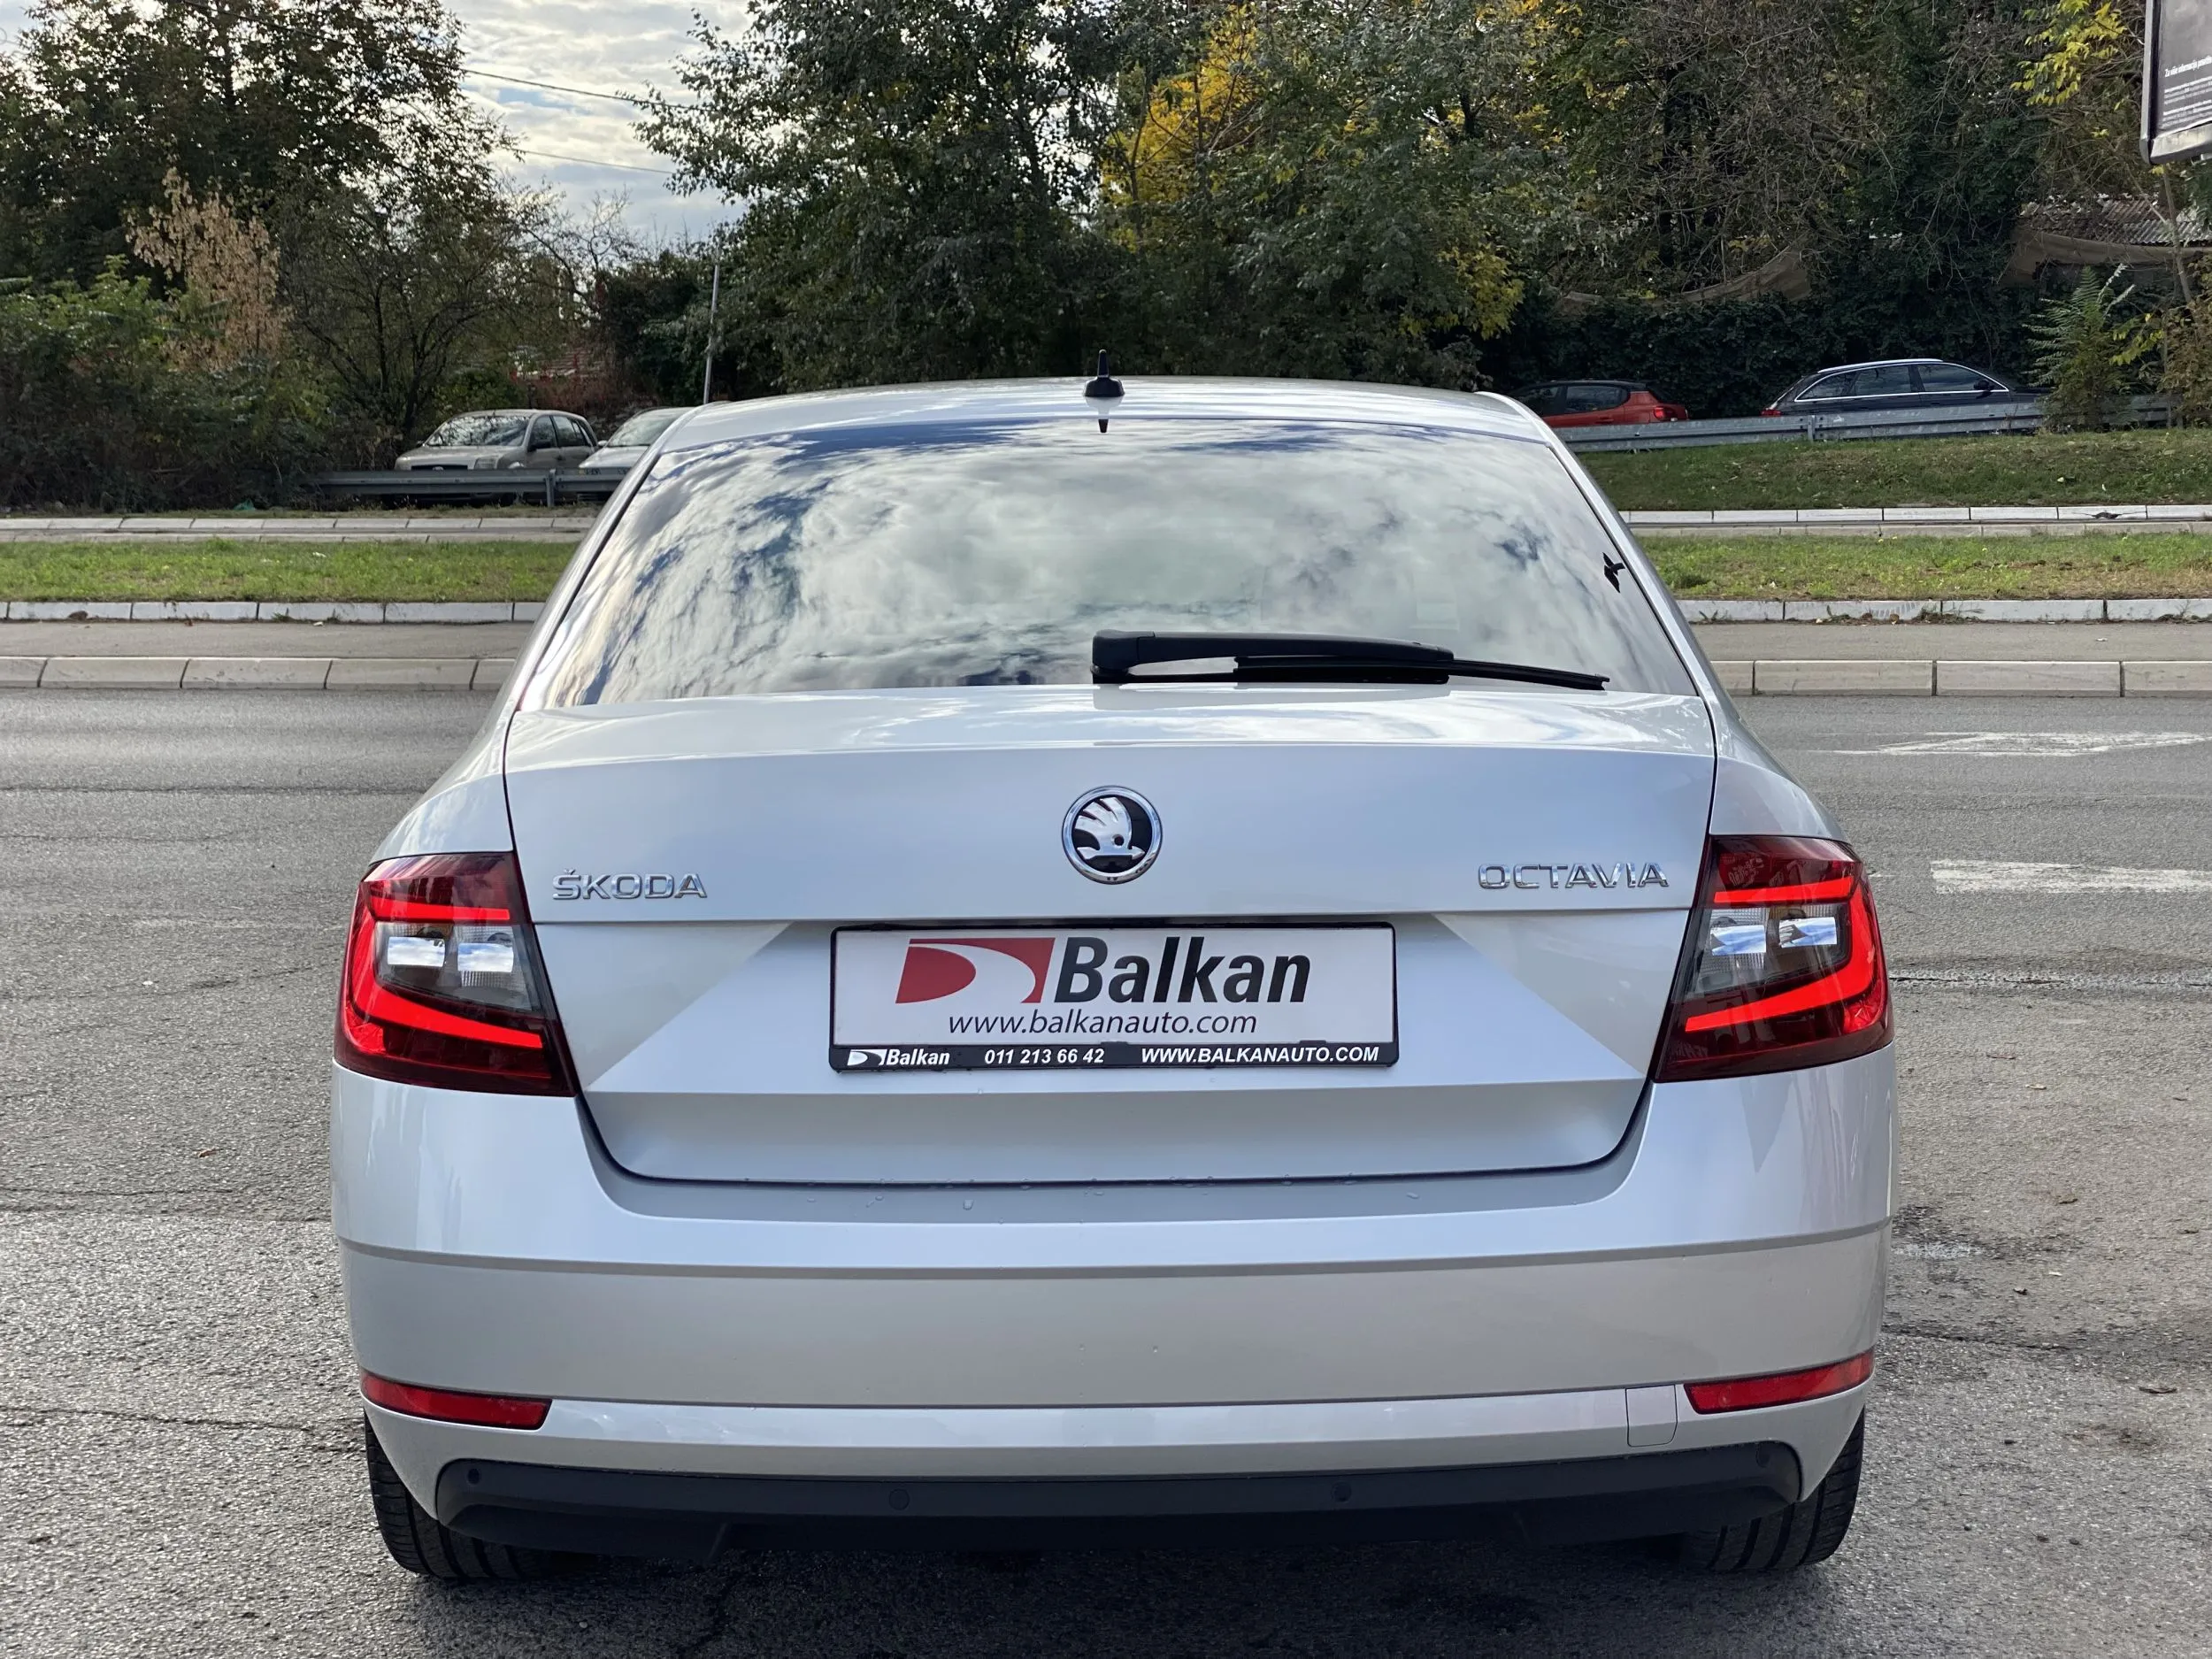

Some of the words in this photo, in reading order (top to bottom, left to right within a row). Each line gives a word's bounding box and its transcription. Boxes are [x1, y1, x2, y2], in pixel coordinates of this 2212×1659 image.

[552, 868, 707, 899] ŠKODA
[1478, 863, 1670, 888] OCTAVIA
[1054, 936, 1310, 1003] Balkan
[949, 1009, 1257, 1033] www.balkanauto.com
[887, 1048, 950, 1065] Balkan
[984, 1049, 1013, 1064] 011
[1020, 1049, 1051, 1064] 213
[1056, 1049, 1078, 1064] 66
[1082, 1048, 1104, 1064] 42
[1141, 1046, 1379, 1064] WWW.BALKANAUTO.COM
